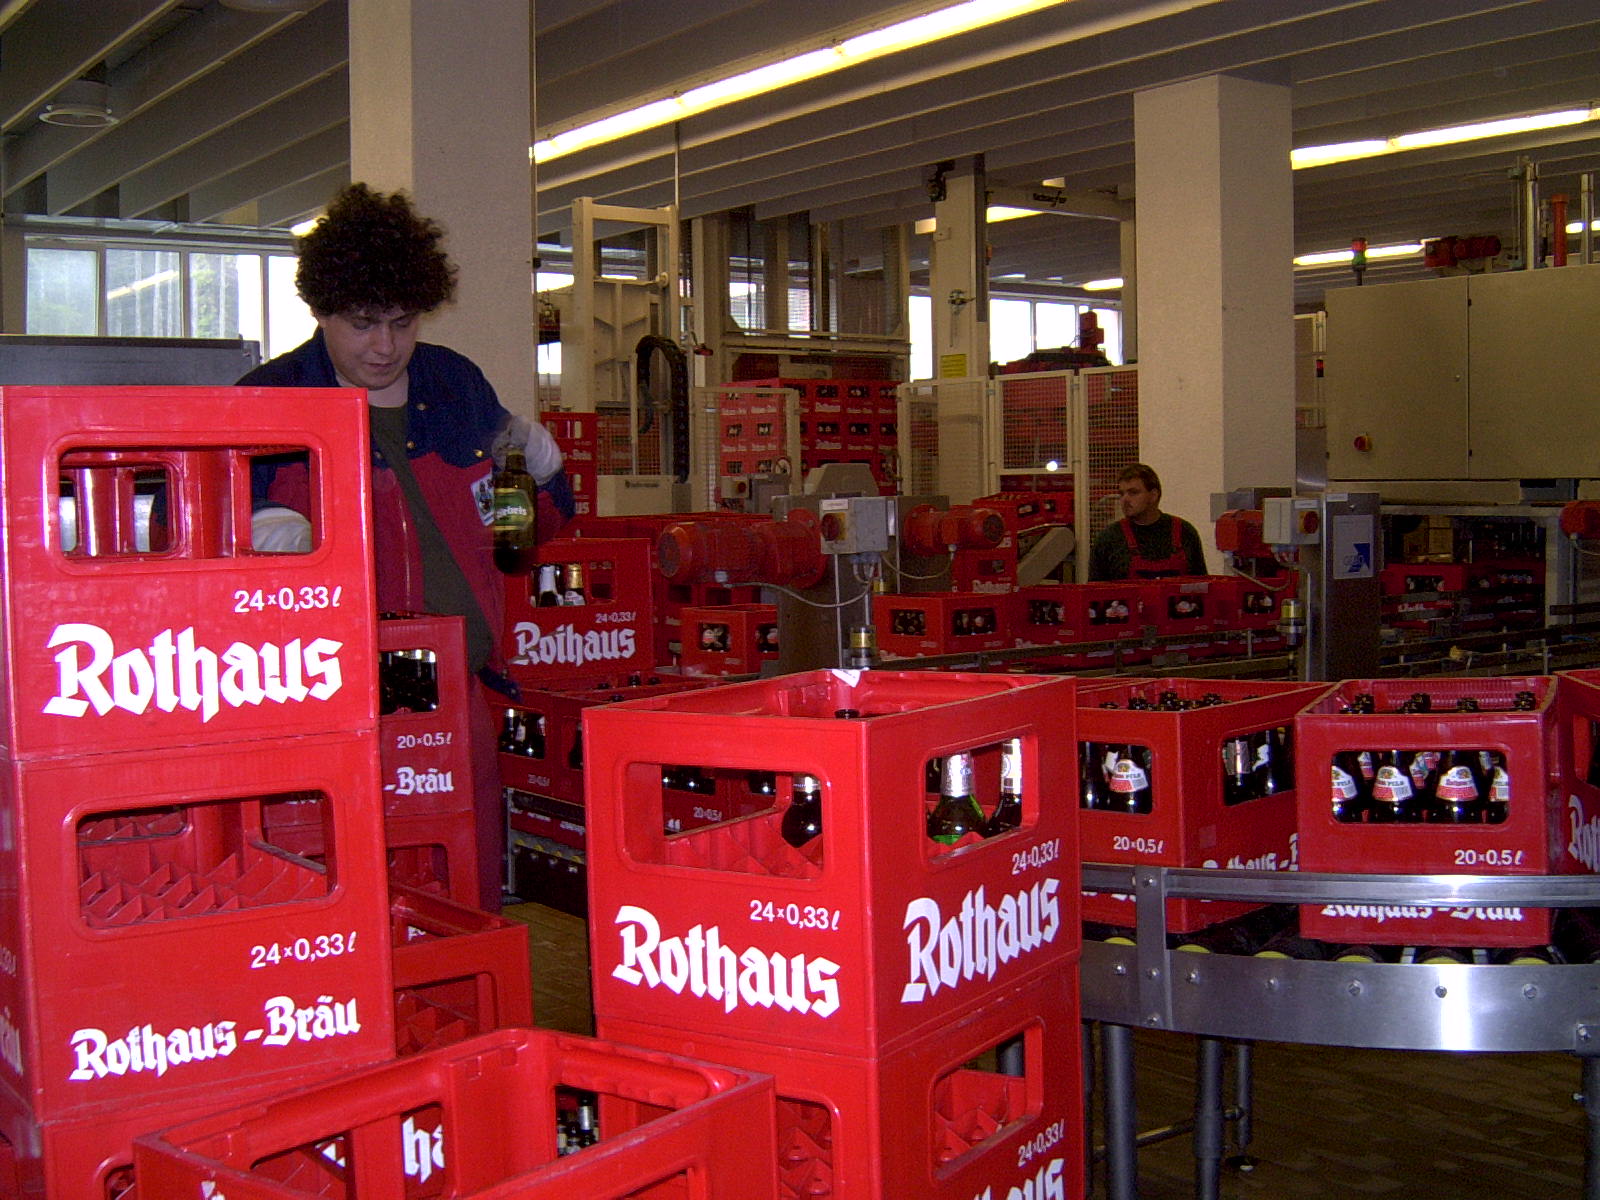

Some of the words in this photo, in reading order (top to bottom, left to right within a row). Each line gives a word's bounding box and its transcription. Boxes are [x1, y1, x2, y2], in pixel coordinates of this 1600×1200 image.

[42, 623, 343, 723] Rothaus
[509, 621, 636, 668] Rothaus
[612, 905, 841, 1018] Rothaus
[901, 878, 1061, 1004] Rothaus
